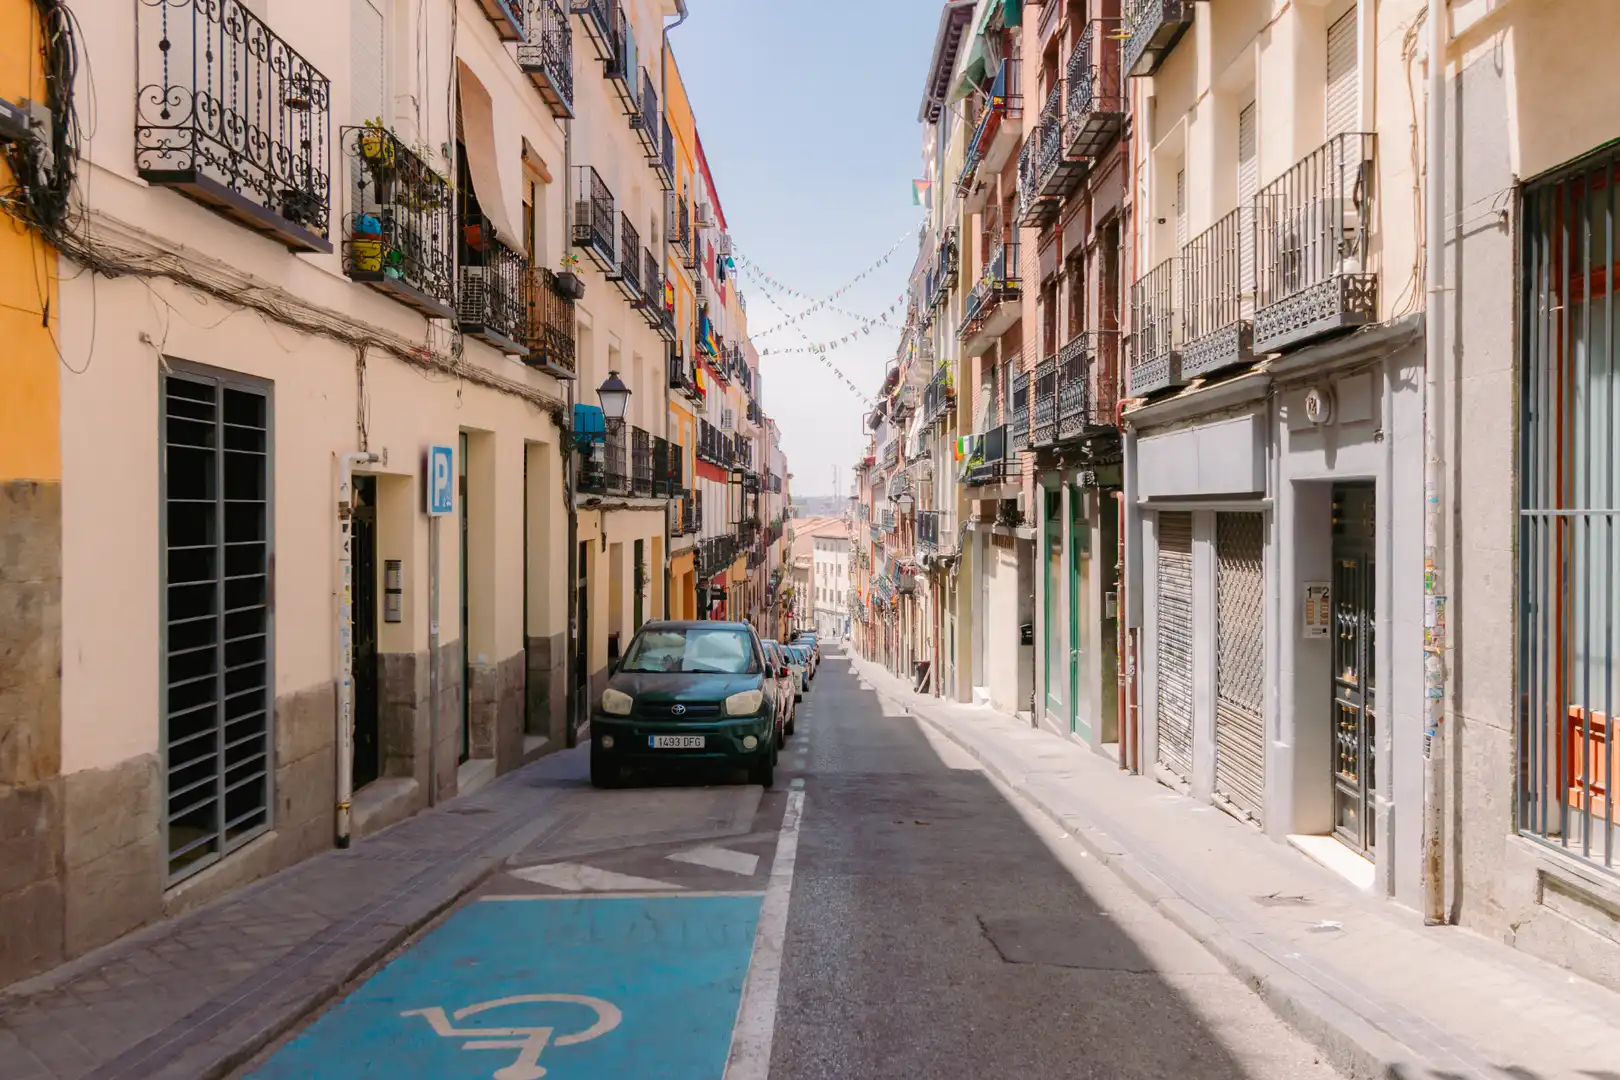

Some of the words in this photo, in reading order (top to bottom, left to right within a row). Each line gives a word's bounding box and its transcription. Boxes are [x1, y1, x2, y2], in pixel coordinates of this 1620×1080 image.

[435, 453, 448, 507] P
[1306, 586, 1312, 599] 1
[1322, 586, 1329, 598] 2
[659, 737, 680, 747] 1493
[683, 737, 701, 747] DFG
